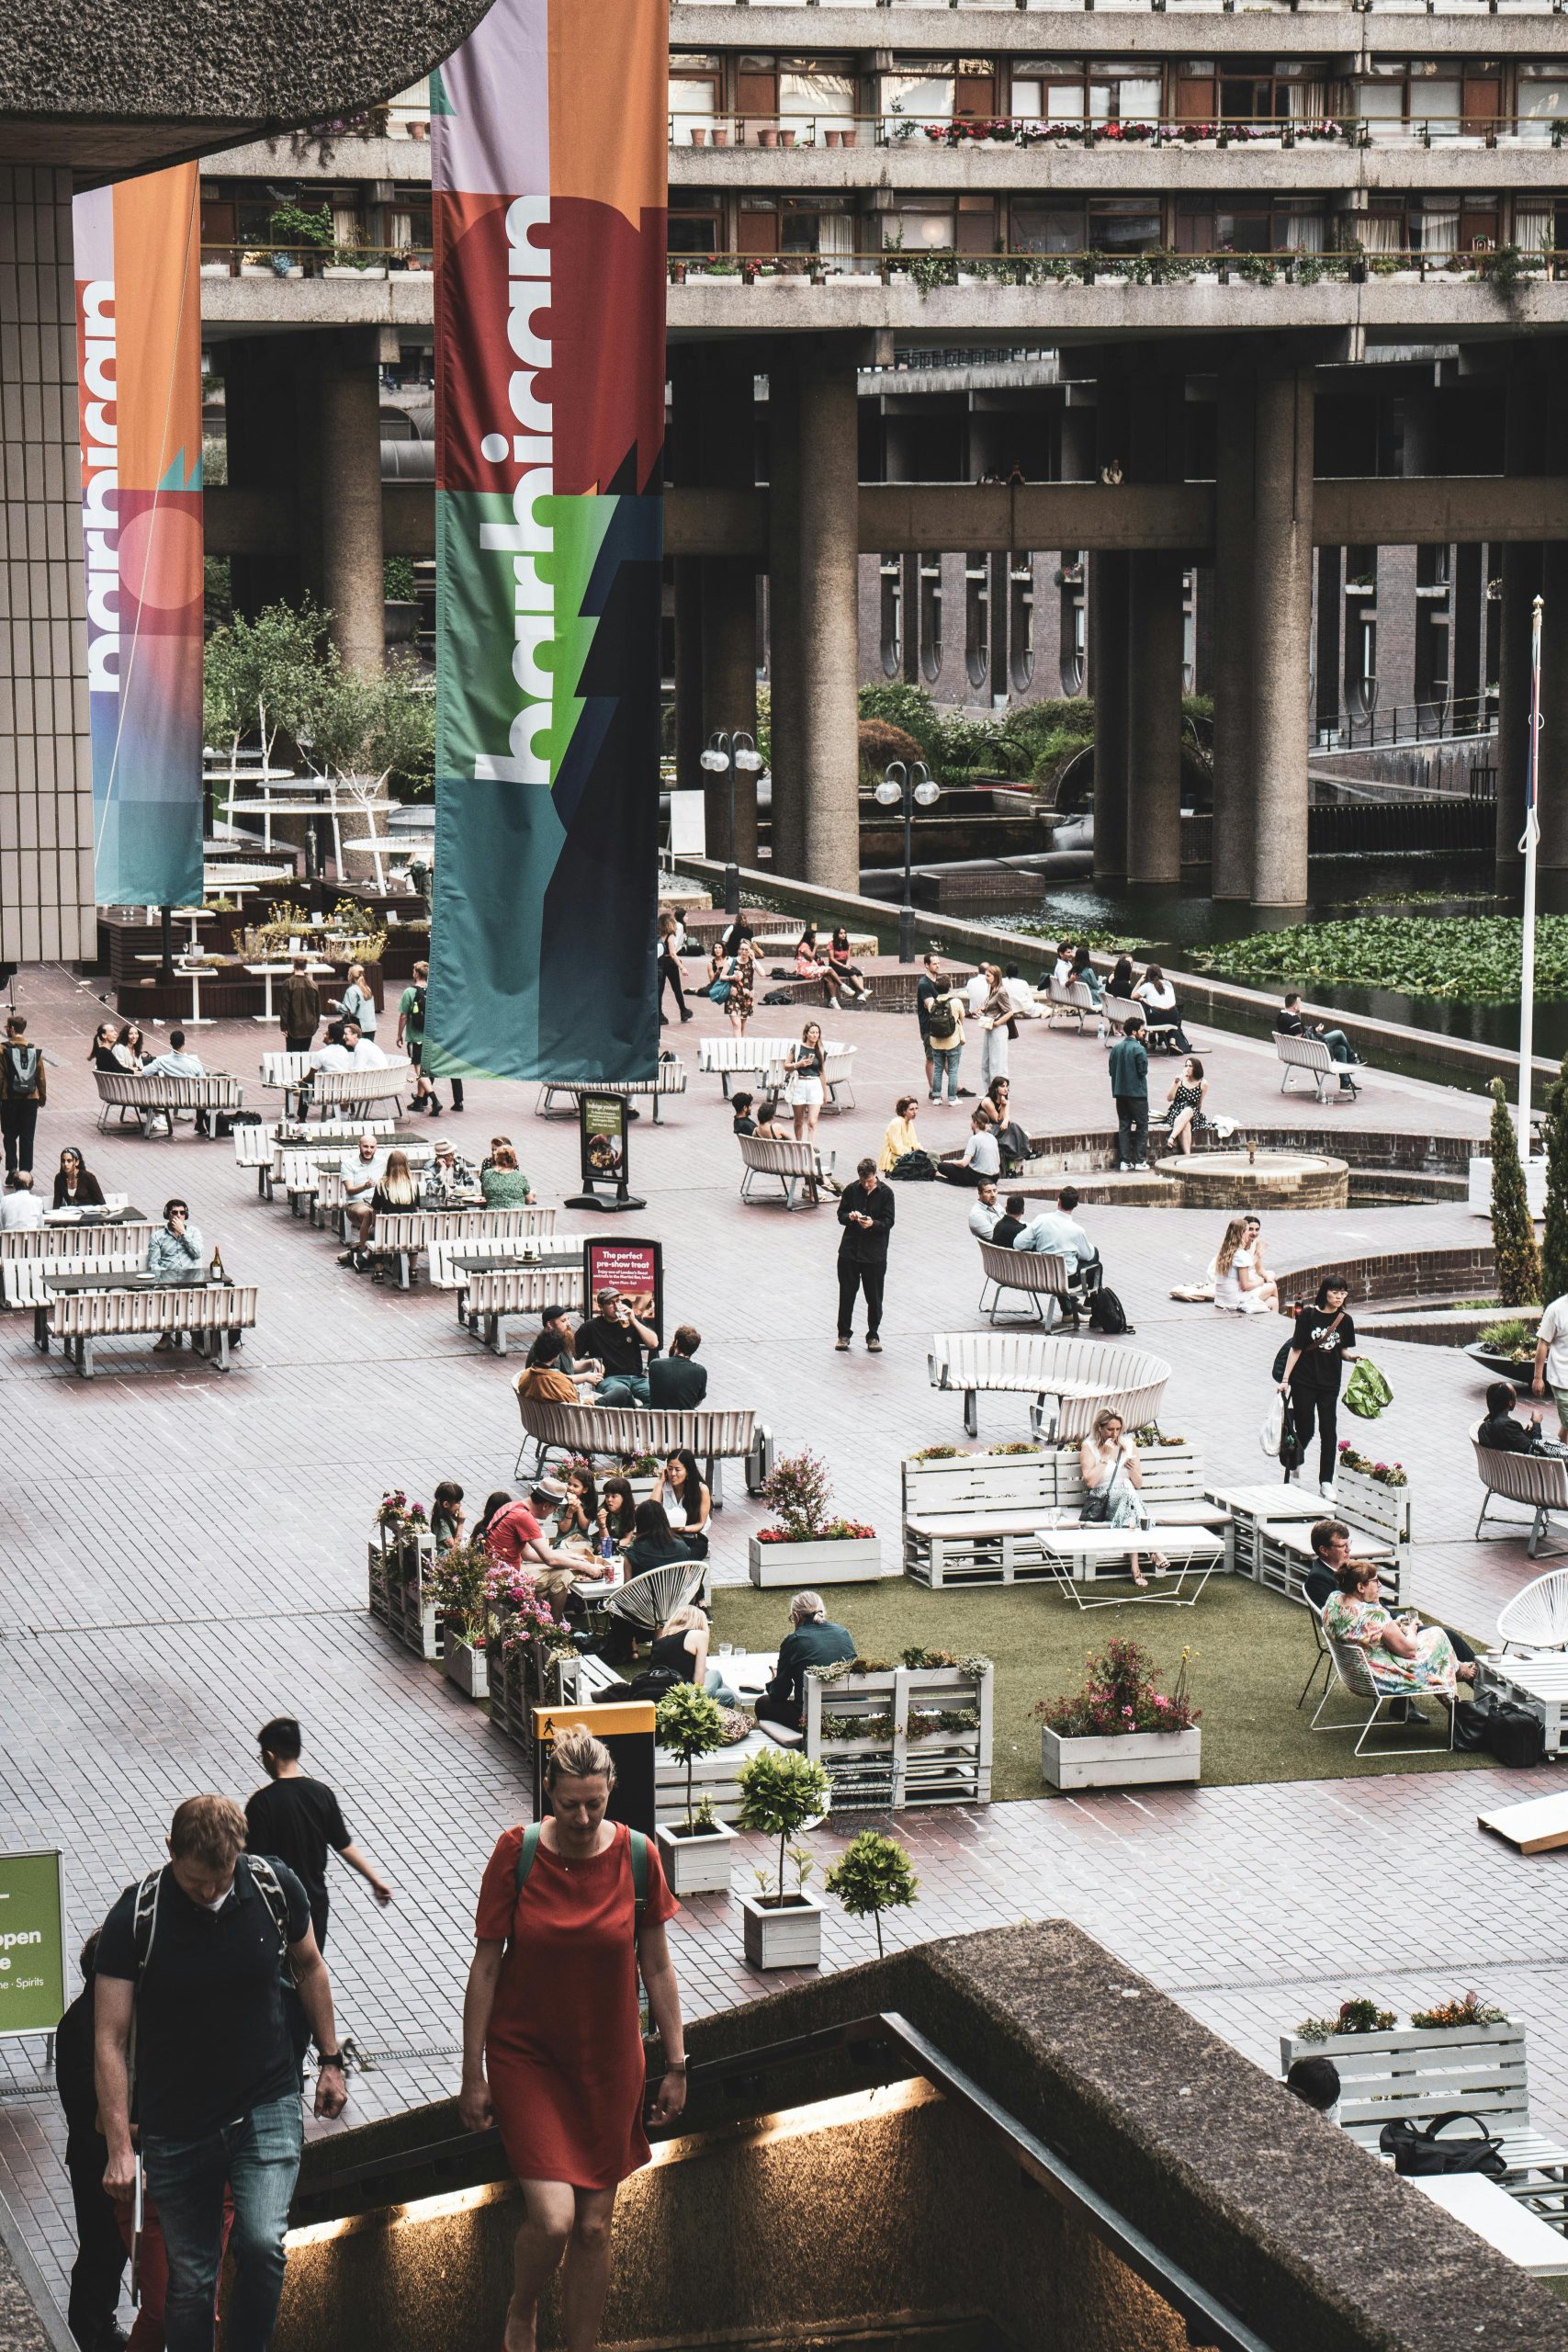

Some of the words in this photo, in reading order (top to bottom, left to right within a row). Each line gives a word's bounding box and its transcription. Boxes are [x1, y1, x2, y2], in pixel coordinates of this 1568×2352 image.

[474, 195, 555, 785] barbican
[603, 1250, 615, 1259] The
[616, 1251, 643, 1261] perfect
[596, 1261, 630, 1269] pre-show
[16, 1976, 44, 1990] Spirits
